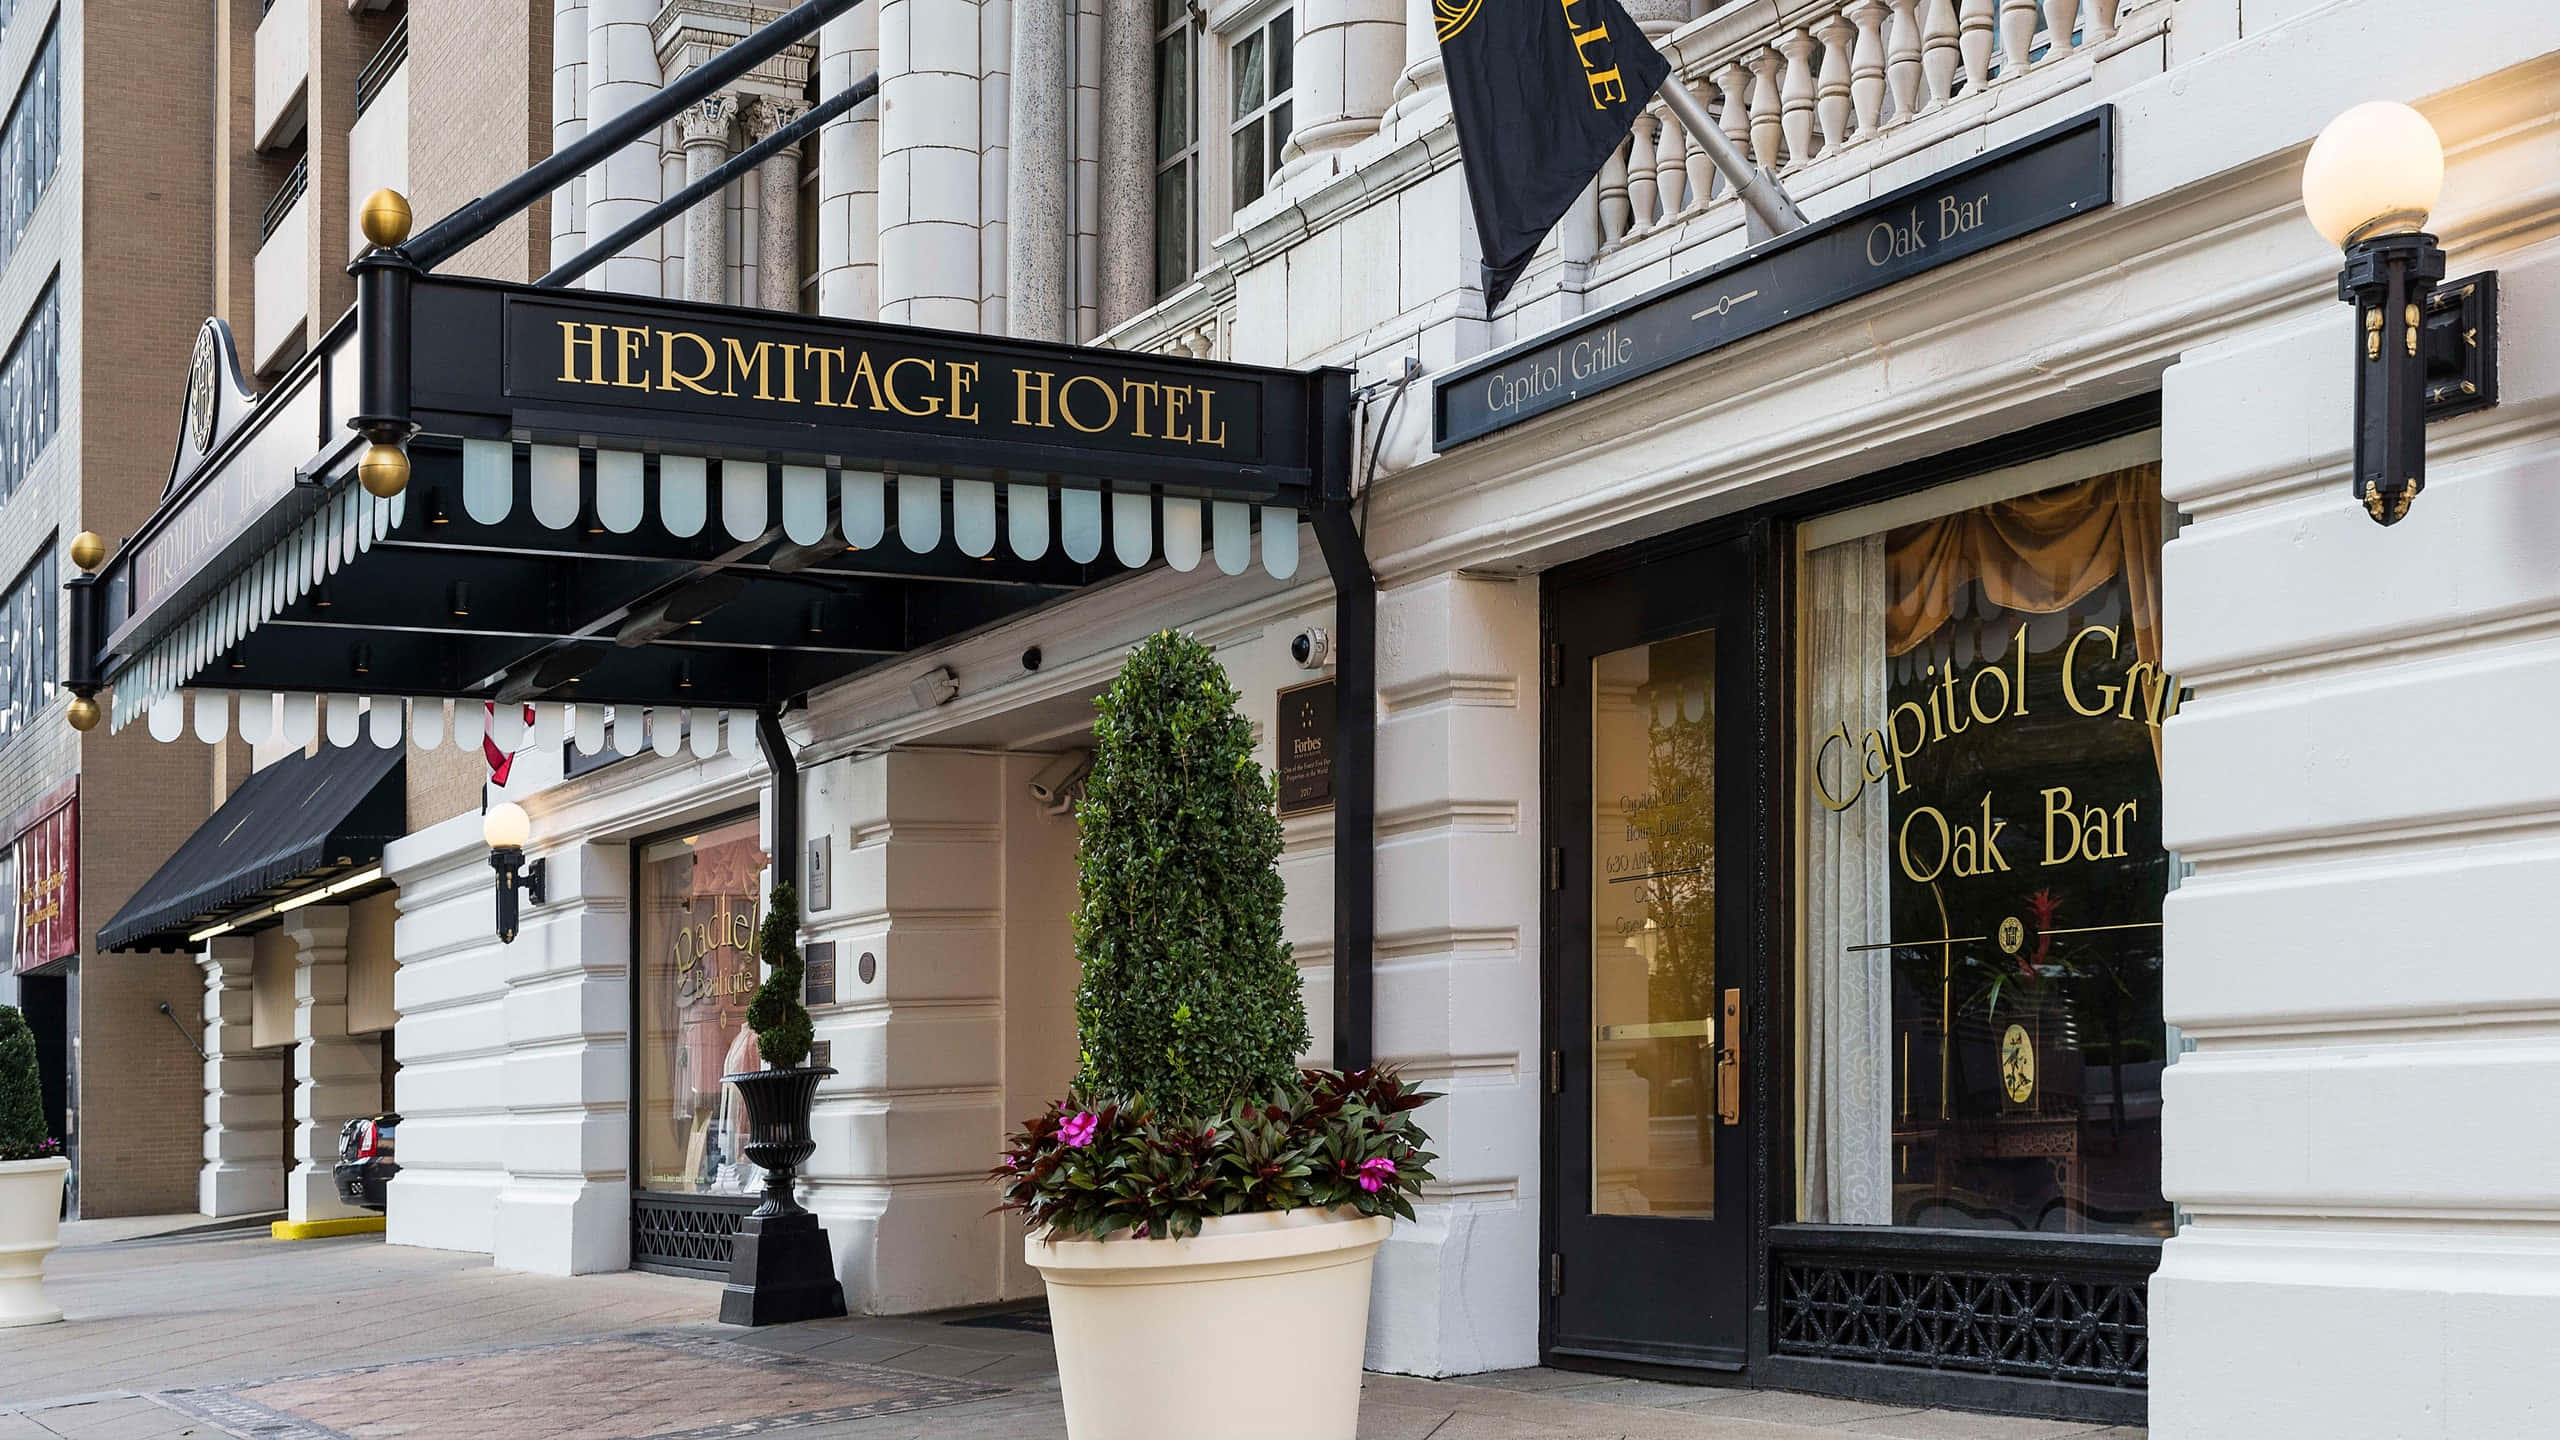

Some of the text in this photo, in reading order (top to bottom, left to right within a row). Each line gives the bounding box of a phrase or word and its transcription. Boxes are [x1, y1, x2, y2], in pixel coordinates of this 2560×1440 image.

[1865, 192, 1990, 268] Oak Bar
[555, 319, 1226, 449] HERMITAGE HOTEL
[1486, 327, 1634, 415] Capitol Grille
[147, 474, 227, 600] HERMITAGE
[1293, 736, 1321, 754] Forbes
[1809, 621, 2181, 813] Capitol Gri
[1899, 785, 2138, 884] Oak Bar
[695, 967, 754, 1006] Boutique
